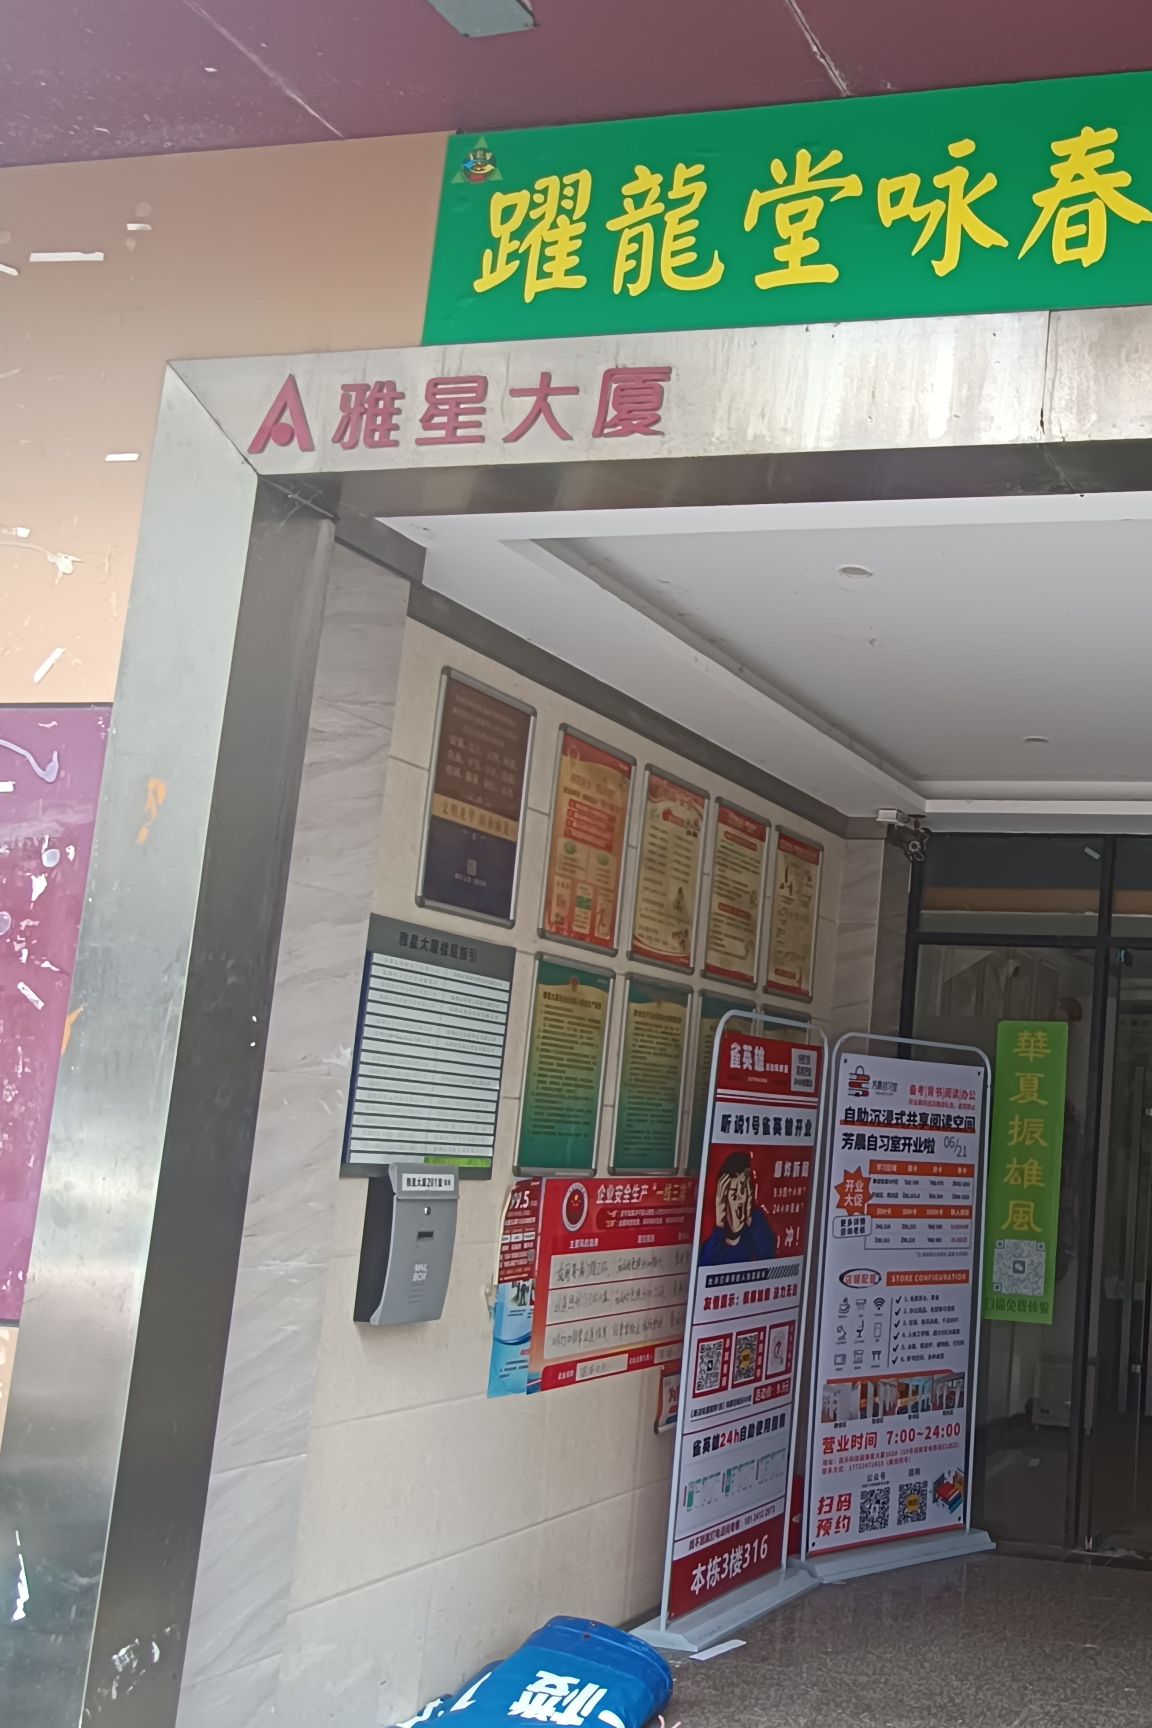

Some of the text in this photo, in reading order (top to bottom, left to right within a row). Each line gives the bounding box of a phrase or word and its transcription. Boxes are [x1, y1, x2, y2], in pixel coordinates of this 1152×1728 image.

[331, 366, 673, 450] 雅星大厦
[844, 1105, 976, 1130] 自助沉浸式共享阅读空间
[841, 1131, 936, 1155] 芳晨自习室开业啦
[1000, 1030, 1052, 1233] 華夏振雄風
[844, 1179, 864, 1193] 开业
[843, 1193, 864, 1207] 大促
[412, 1272, 428, 1282] BOX
[822, 1431, 878, 1455] 营业时间
[886, 1422, 961, 1445] 7:00~24:00
[817, 1492, 852, 1516] 扫码
[816, 1515, 852, 1538] 预约
[690, 1533, 769, 1596] 本栋3楼316
